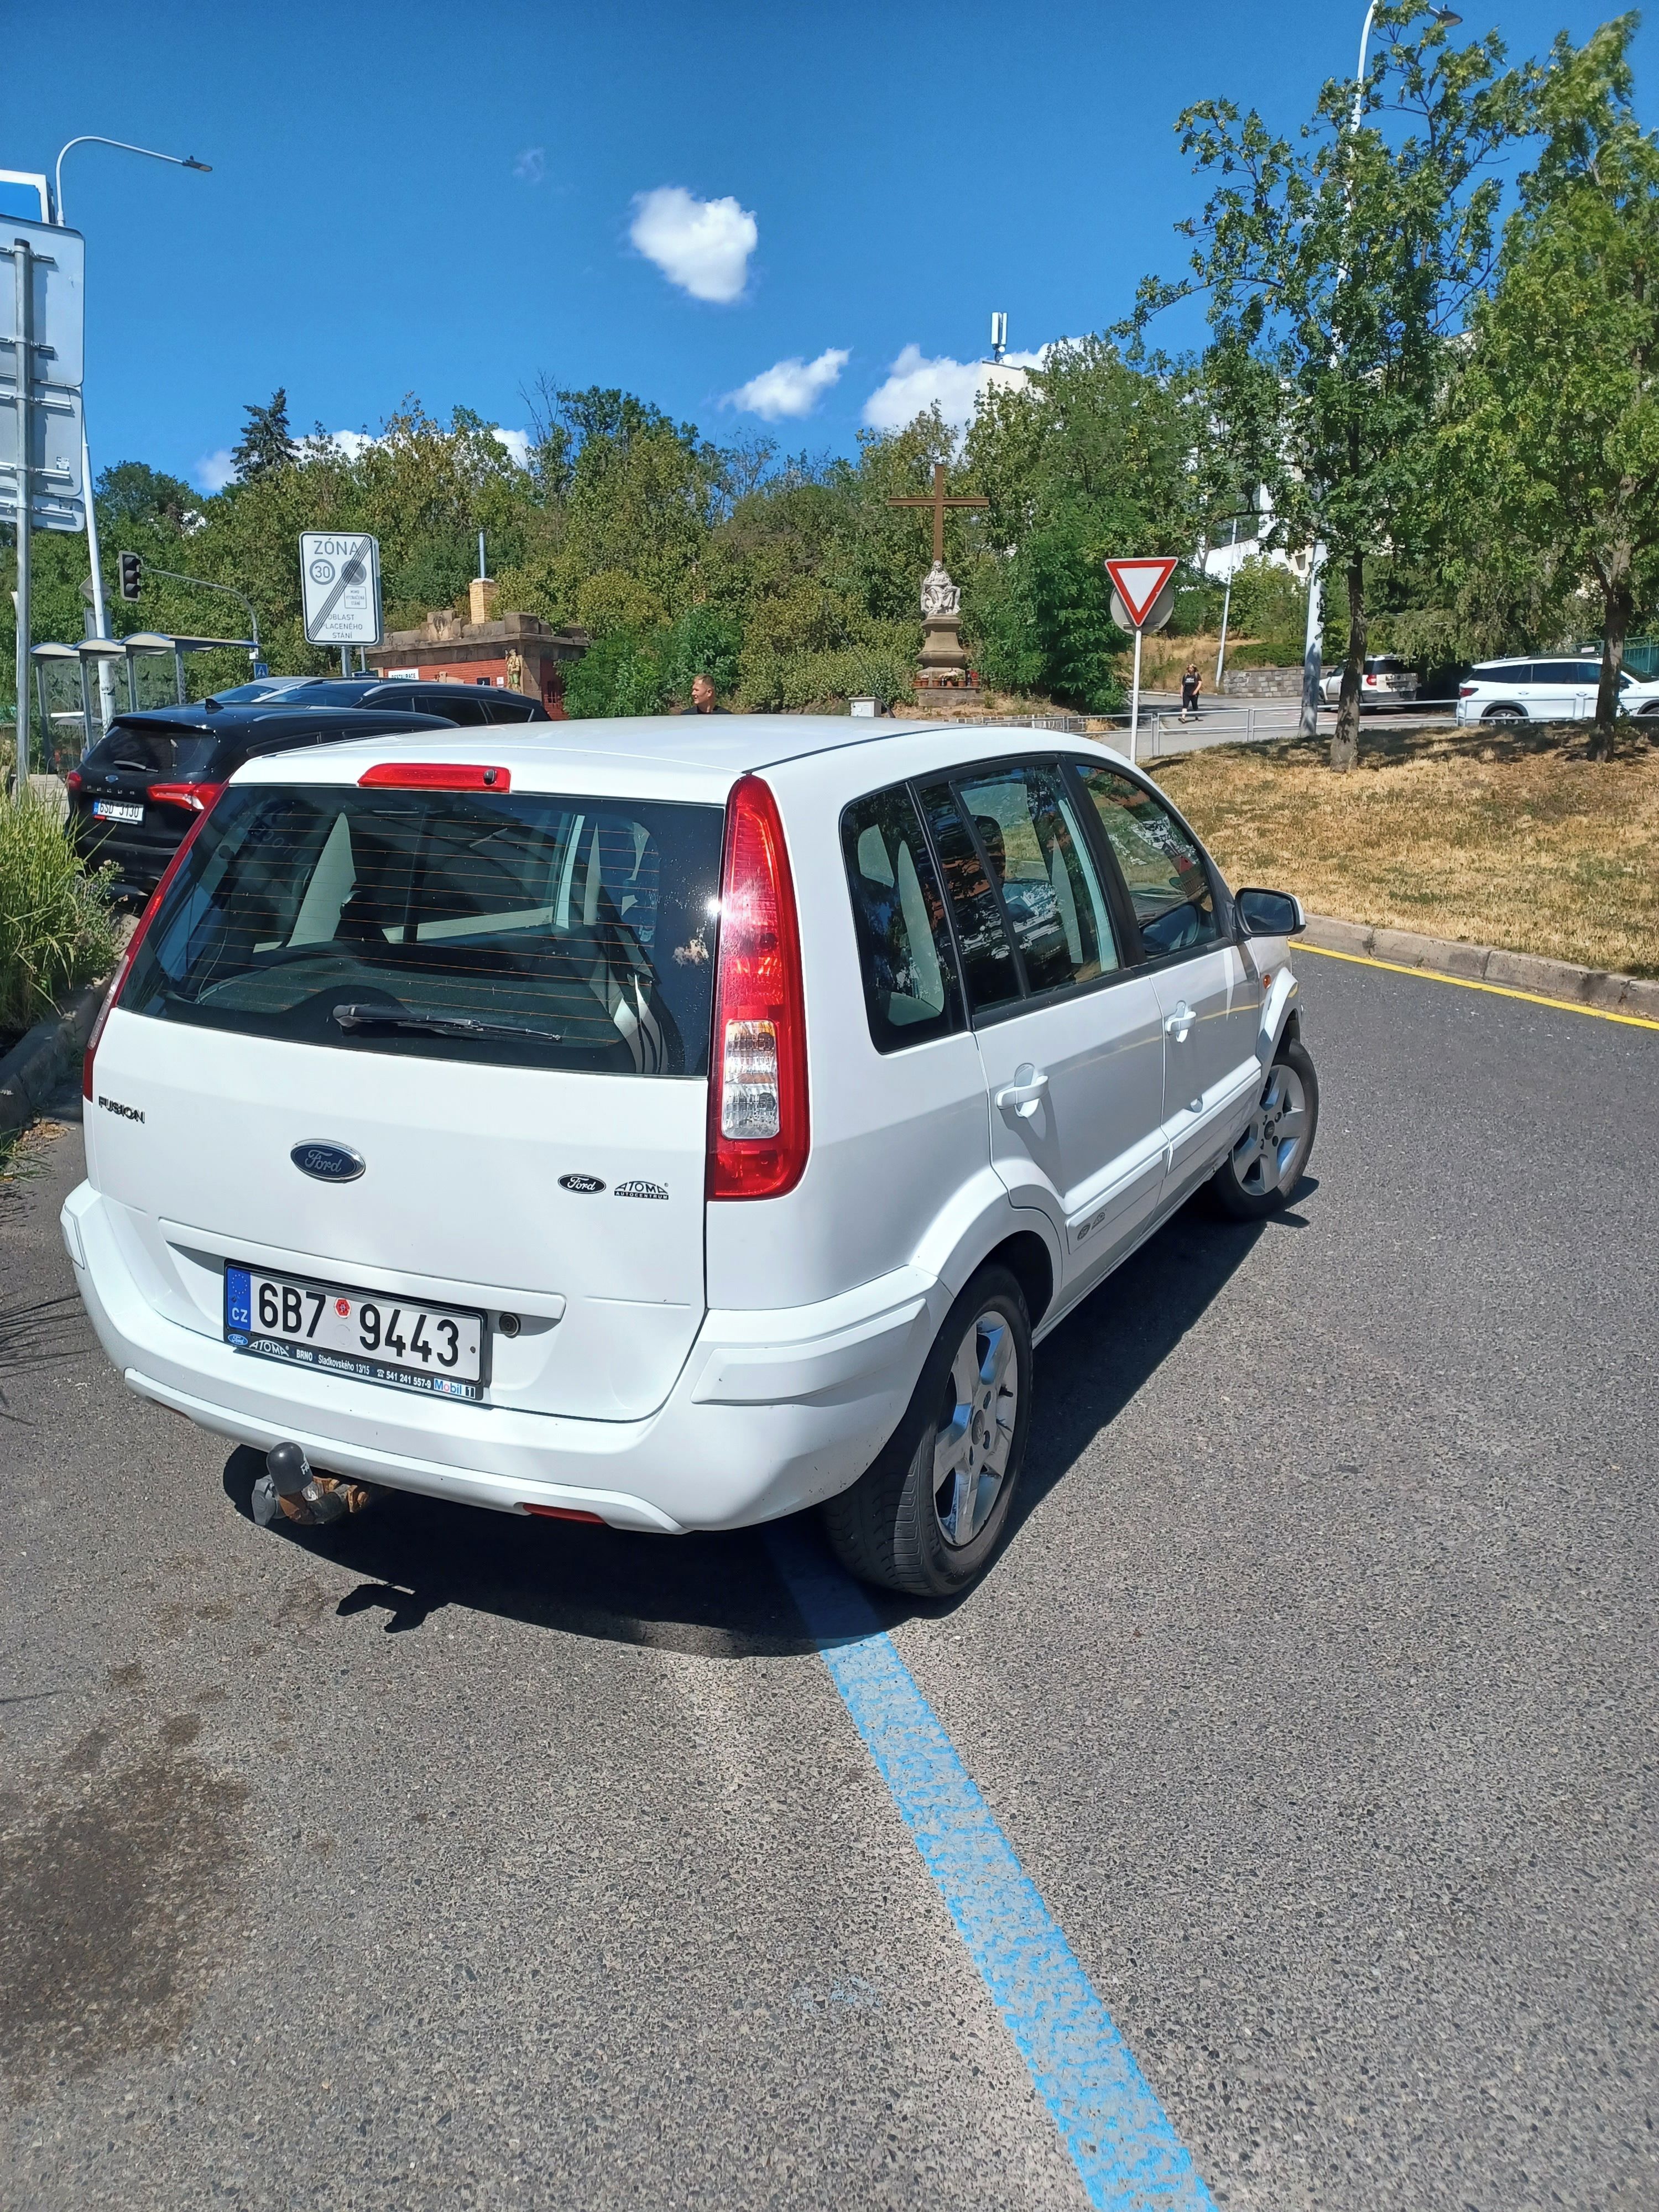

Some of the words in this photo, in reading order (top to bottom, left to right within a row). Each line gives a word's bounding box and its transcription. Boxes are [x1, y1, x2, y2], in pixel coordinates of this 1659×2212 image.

[314, 538, 359, 555] ZÓNA
[315, 566, 330, 578] 30
[98, 1095, 145, 1124] FUSION
[305, 1149, 343, 1173] Ford
[567, 1176, 596, 1191] Ford
[615, 1181, 669, 1194] ATOMA
[615, 1191, 668, 1199] AUTOCENTRUM
[232, 1308, 248, 1323] CZ
[259, 1282, 326, 1338] 6B7
[359, 1303, 459, 1367] 9443
[231, 1335, 244, 1344] Ford
[249, 1339, 290, 1357] ATOMA
[296, 1349, 313, 1361] BRNO
[318, 1354, 354, 1371] Sladkovského
[356, 1363, 369, 1375] 13/15
[386, 1371, 398, 1381] 541
[399, 1374, 411, 1384] 241
[413, 1377, 431, 1389] 557-9
[435, 1379, 462, 1395] Mobil
